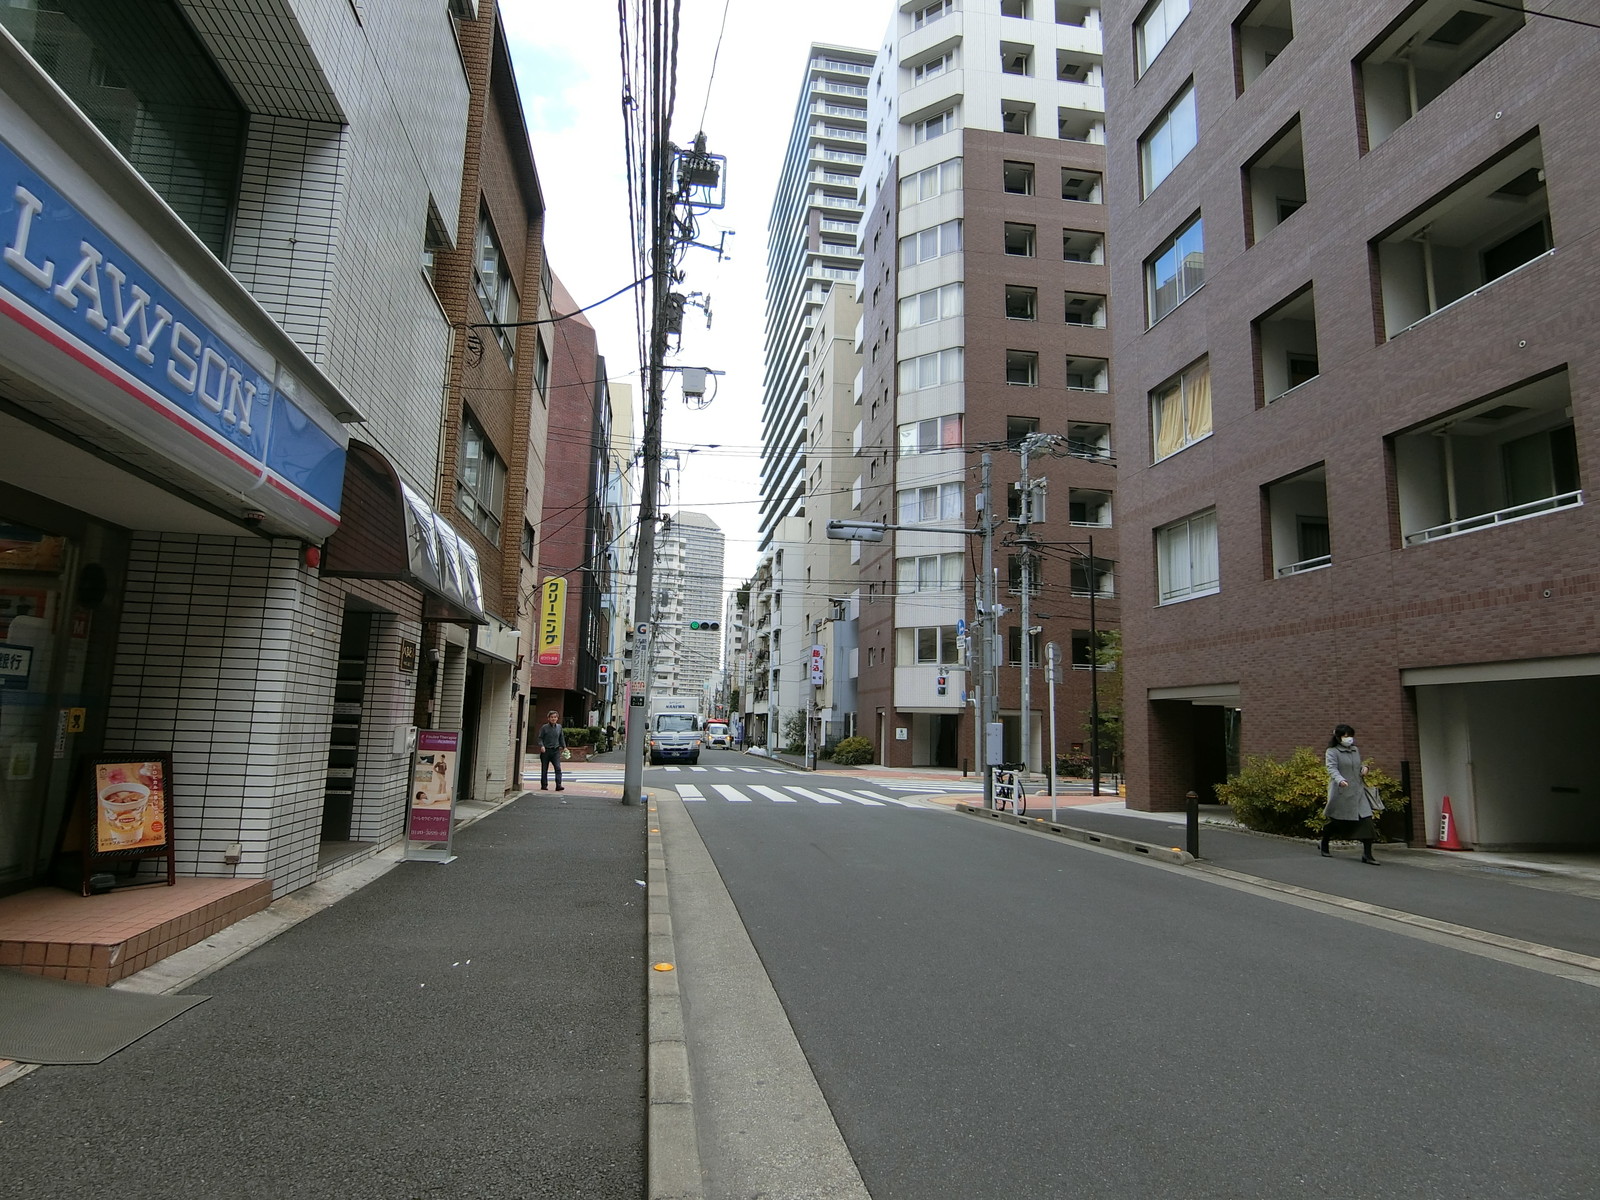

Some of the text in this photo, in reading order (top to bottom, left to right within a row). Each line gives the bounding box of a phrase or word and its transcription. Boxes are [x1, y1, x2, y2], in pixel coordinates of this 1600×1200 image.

[4, 185, 257, 436] LAWSON
[545, 582, 559, 645] クリーニング
